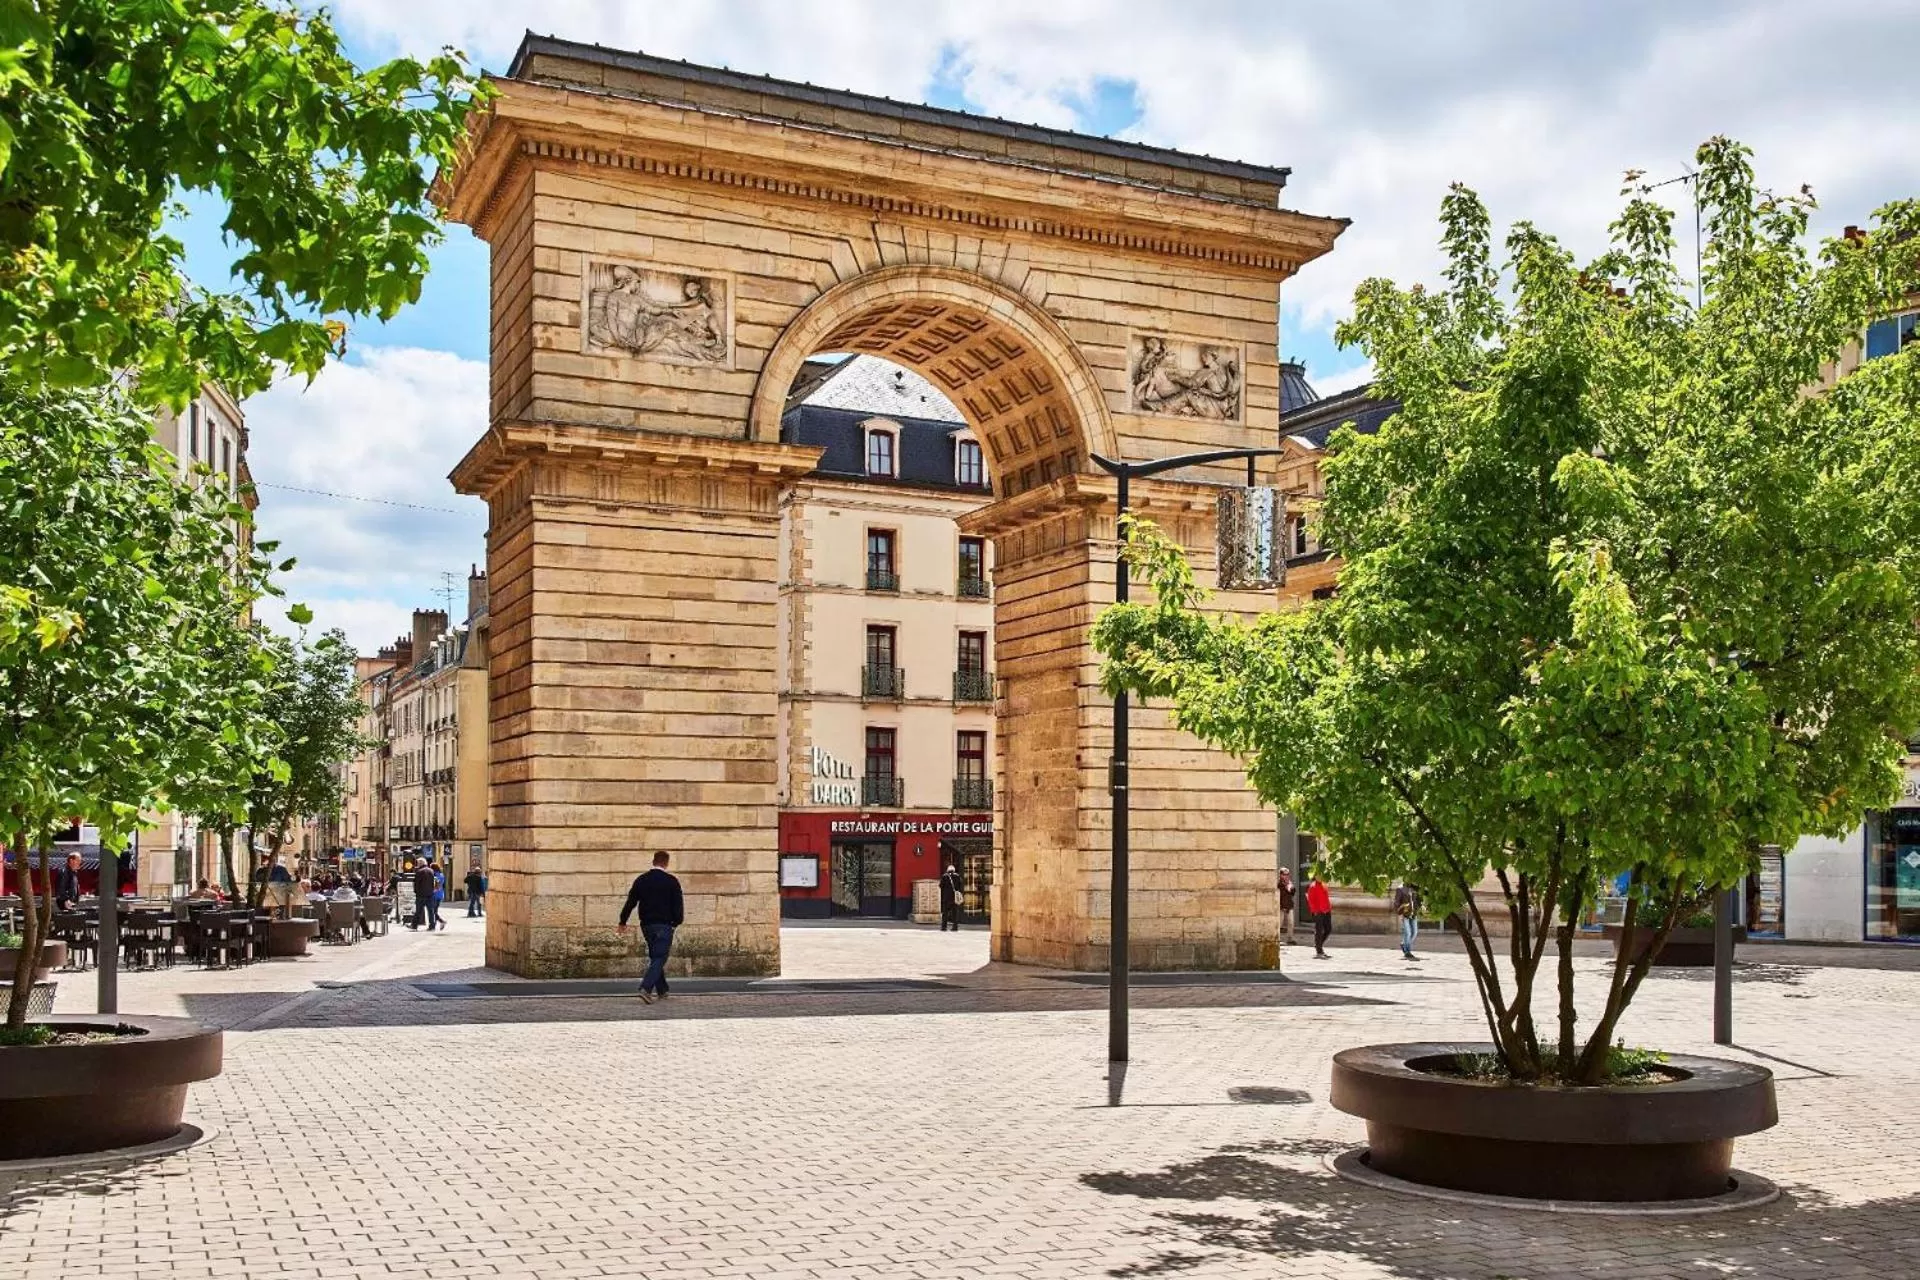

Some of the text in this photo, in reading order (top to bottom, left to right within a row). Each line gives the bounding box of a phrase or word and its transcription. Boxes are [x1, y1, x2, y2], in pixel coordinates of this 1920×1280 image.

[831, 821, 900, 833] RESTAURANT
[902, 822, 918, 833] DE
[920, 822, 934, 833] LA
[936, 822, 969, 833] PORTE
